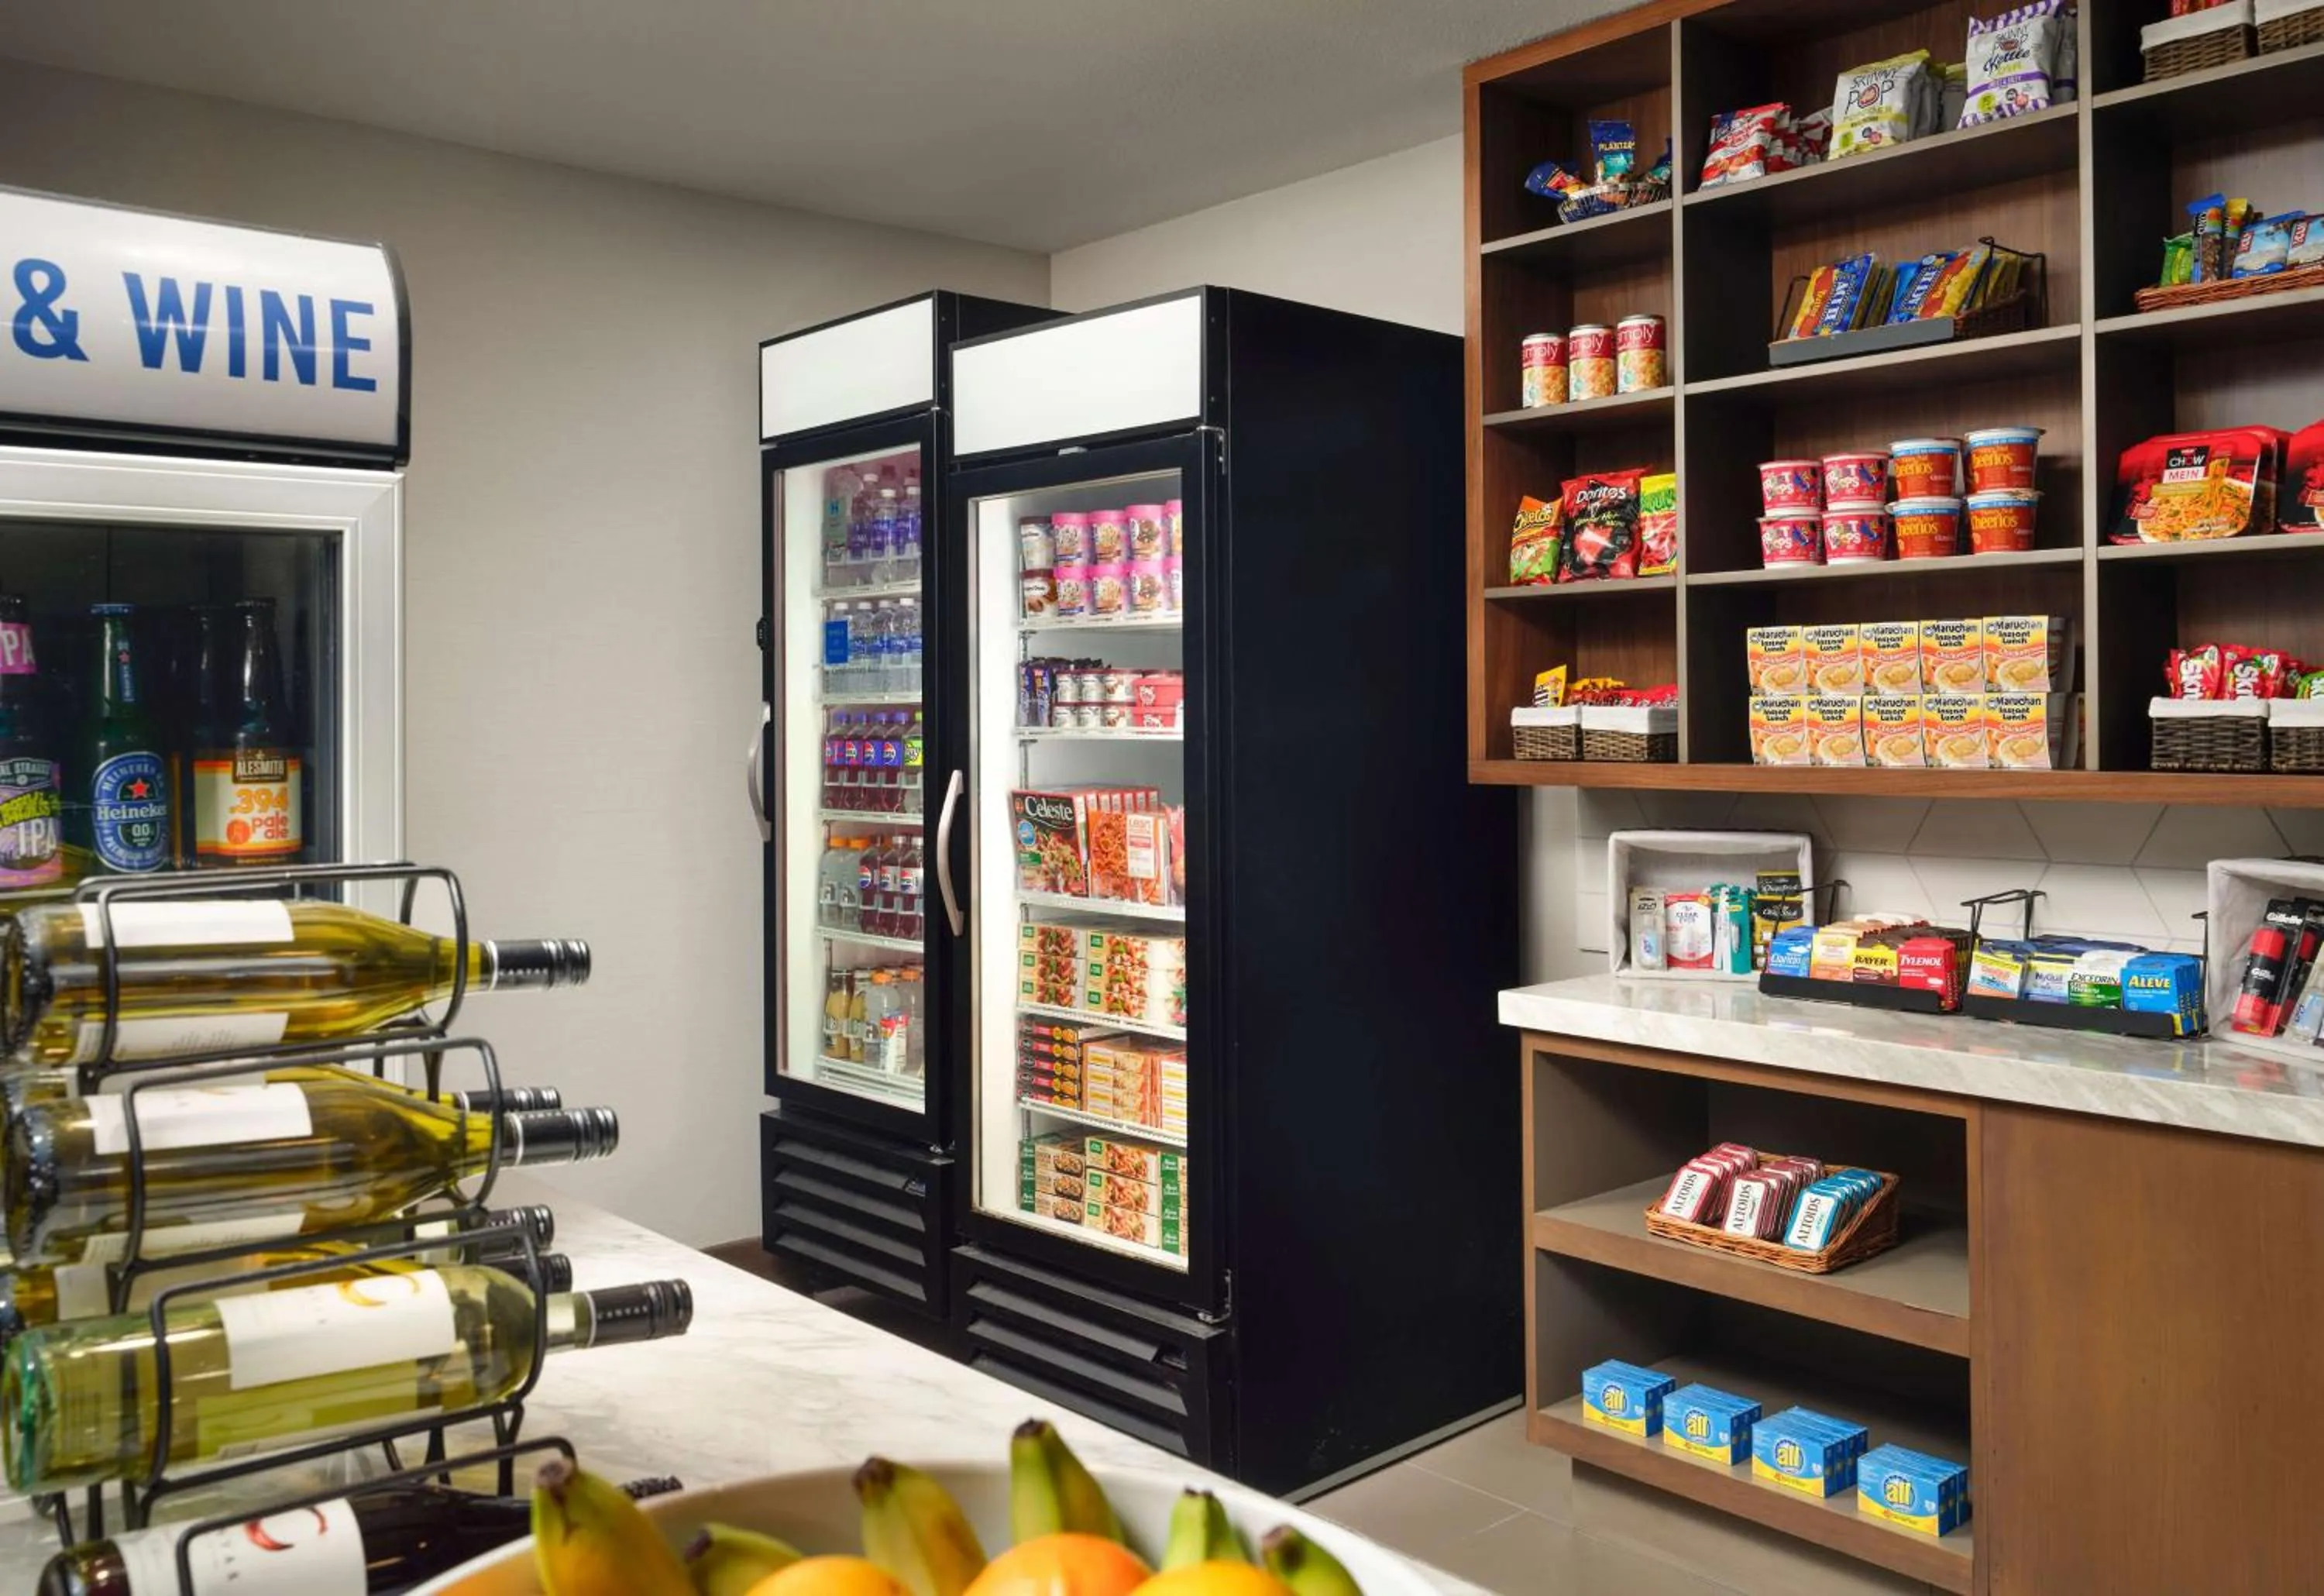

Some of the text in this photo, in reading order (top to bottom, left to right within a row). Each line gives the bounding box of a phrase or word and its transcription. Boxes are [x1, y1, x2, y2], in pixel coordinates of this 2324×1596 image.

[1845, 80, 1895, 115] POP
[13, 258, 377, 392] & WINE
[2168, 469, 2199, 480] MEIN
[1576, 487, 1628, 504] Doritos
[1872, 625, 1913, 635] Maruchan
[1934, 623, 1977, 634] Maruchan
[1996, 619, 2043, 631] Maruchan
[1758, 629, 1797, 640] Maruchan
[1814, 628, 1854, 638] Maruchan
[1761, 699, 1800, 708] Maruchan
[1817, 699, 1857, 708] Maruchan
[1875, 698, 1916, 708] Maruchan
[1934, 697, 1978, 707] Maruchan
[1996, 697, 2041, 707] Maruchan
[236, 759, 286, 776] ALESMITH
[1025, 796, 1074, 820] Celeste
[252, 811, 288, 834] pale
[264, 827, 288, 840] ale
[1855, 954, 1889, 966] BAYER
[1900, 954, 1943, 968] TYLENOL
[2128, 975, 2171, 989] ALEVE
[1671, 1173, 1697, 1213] ALTOIDS
[1734, 1183, 1752, 1230] ALTOIDS
[1796, 1197, 1822, 1243] ALTOIDS
[1604, 1390, 1625, 1412] all
[1686, 1415, 1708, 1438] all
[1776, 1446, 1800, 1467] all
[1886, 1481, 1913, 1505] all
